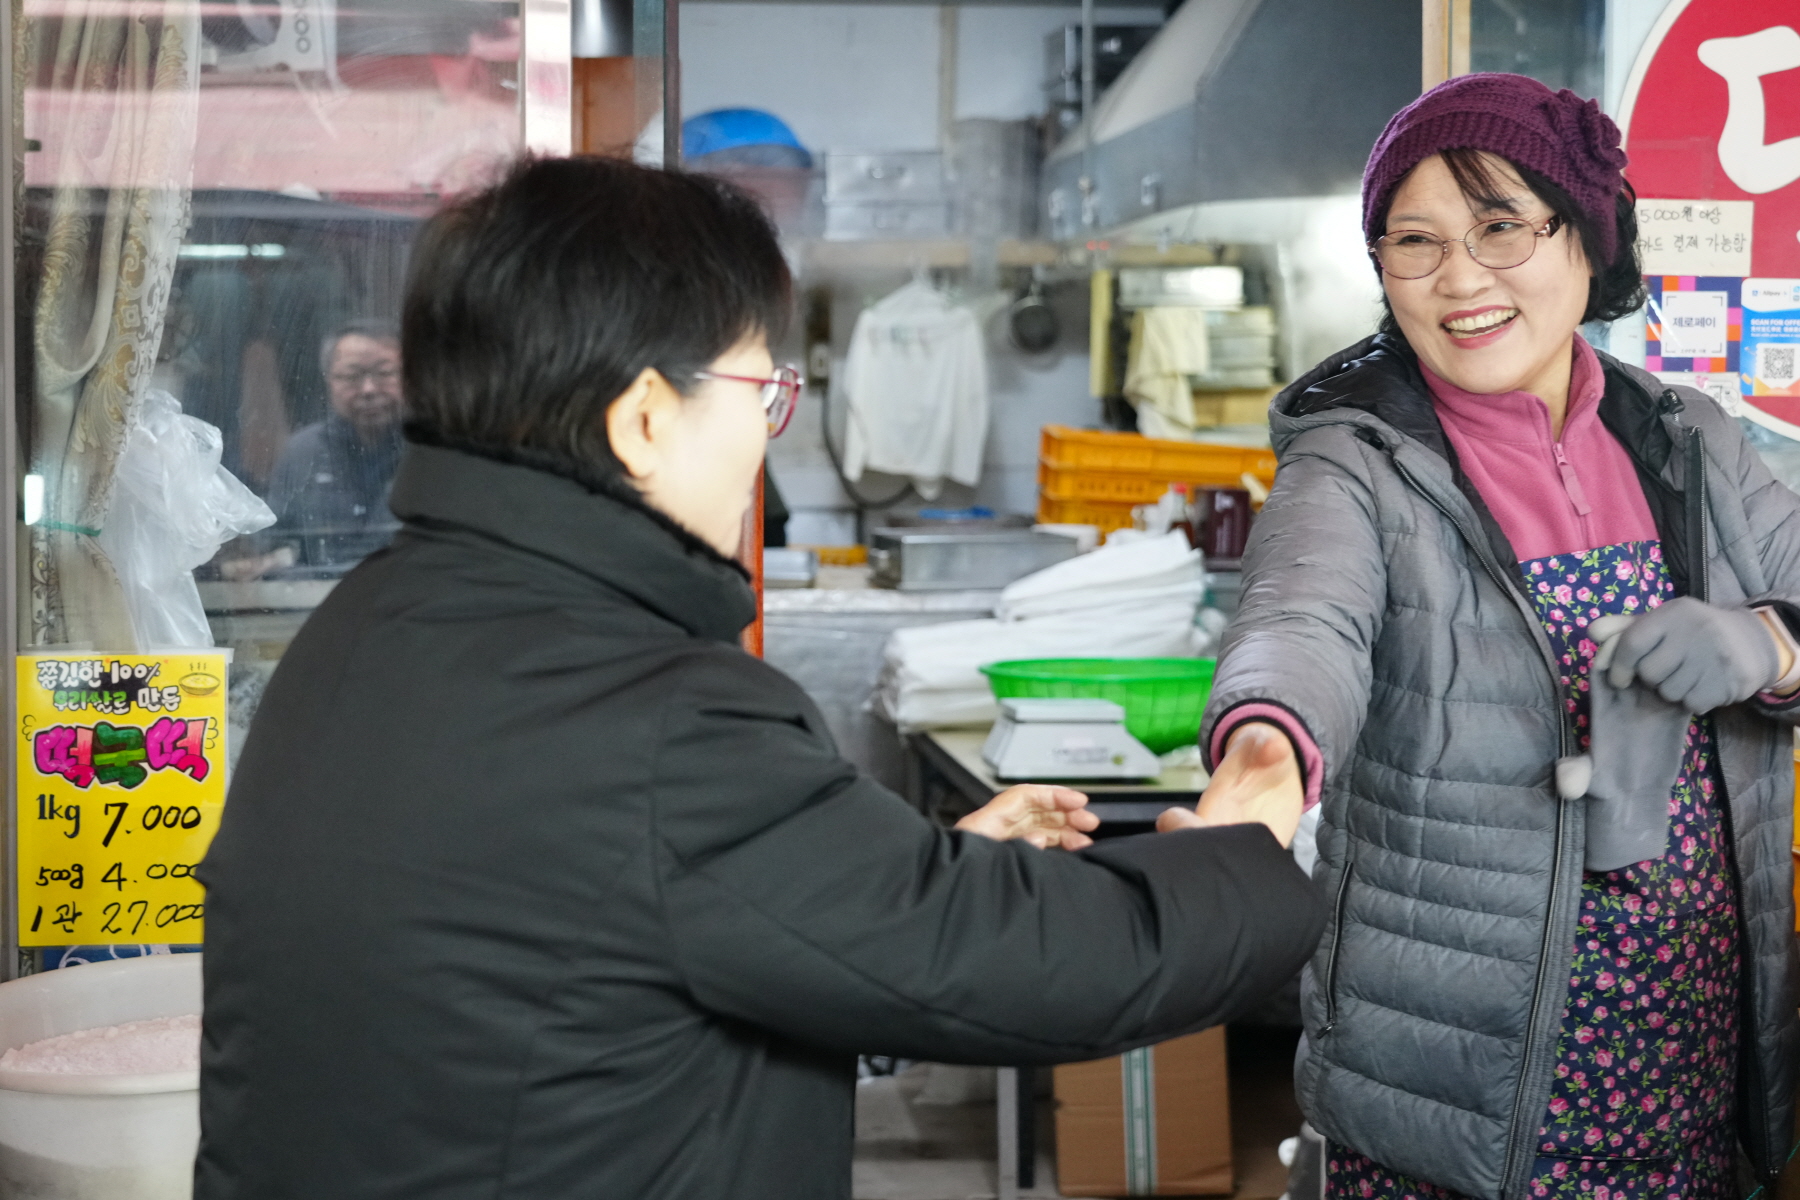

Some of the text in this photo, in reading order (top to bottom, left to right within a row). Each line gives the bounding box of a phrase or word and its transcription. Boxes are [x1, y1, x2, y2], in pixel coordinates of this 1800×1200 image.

[1699, 206, 1722, 224] 이상
[1673, 234, 1698, 253] 결제
[1705, 233, 1747, 253] 가능함
[1672, 316, 1716, 328] 제로페이
[36, 659, 161, 690] 쫄깃한 100%
[53, 685, 181, 715] 우리쌀로 만든
[34, 716, 209, 789] 떡국떡
[36, 794, 202, 847] 1kg 7.000
[36, 863, 84, 889] 500g
